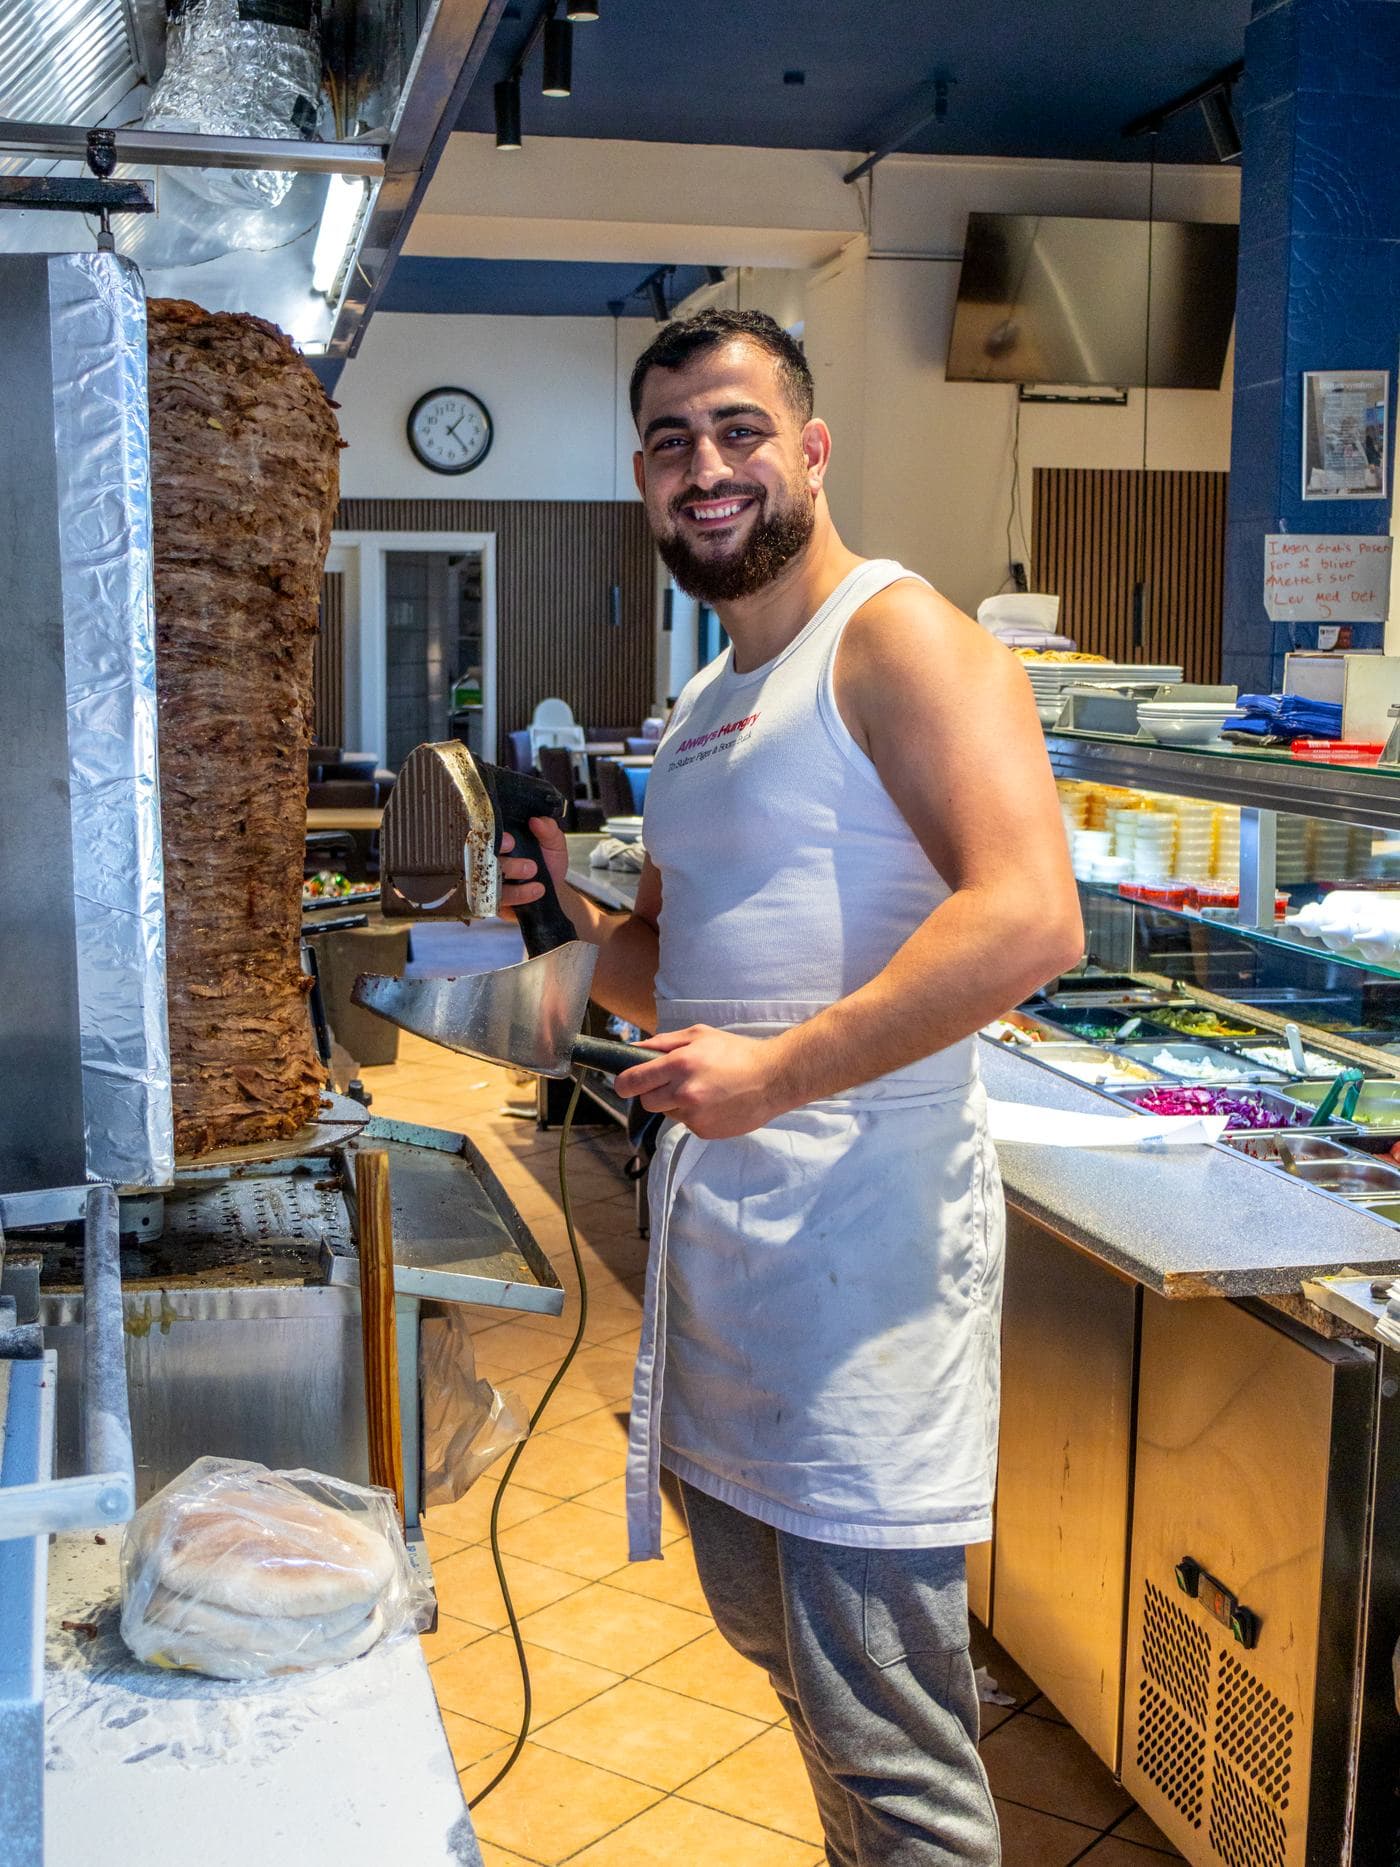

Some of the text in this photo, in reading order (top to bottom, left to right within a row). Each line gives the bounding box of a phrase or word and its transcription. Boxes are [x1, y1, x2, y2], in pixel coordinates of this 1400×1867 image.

[445, 403, 456, 412] 12
[675, 712, 761, 754] Always Hungry
